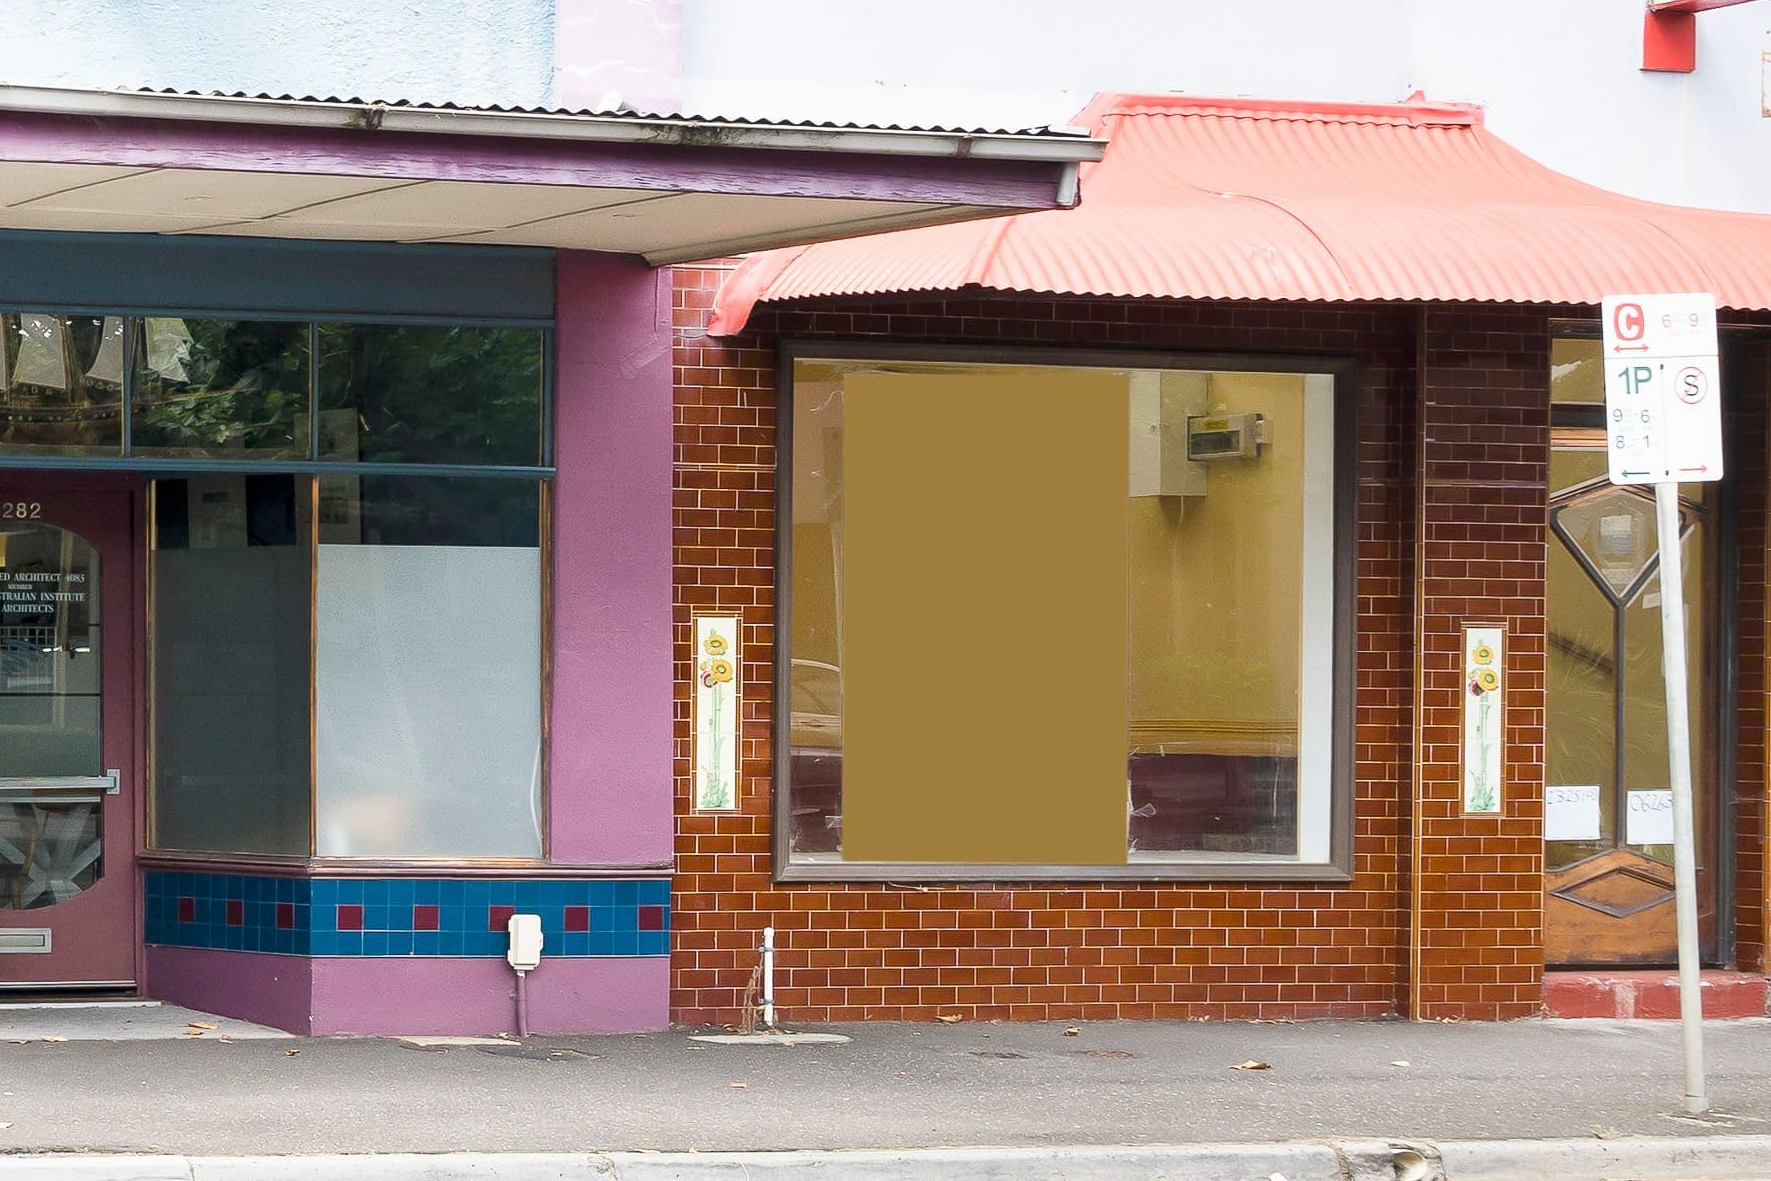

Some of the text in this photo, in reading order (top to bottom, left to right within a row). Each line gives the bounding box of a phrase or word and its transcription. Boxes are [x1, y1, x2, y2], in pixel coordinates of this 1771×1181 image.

[1618, 366, 1653, 395] 1P
[2, 502, 41, 519] 282
[14, 572, 61, 582] ARCHITECT
[40, 592, 85, 602] INSTITUTE
[2, 604, 54, 613] ARCHITECTS
